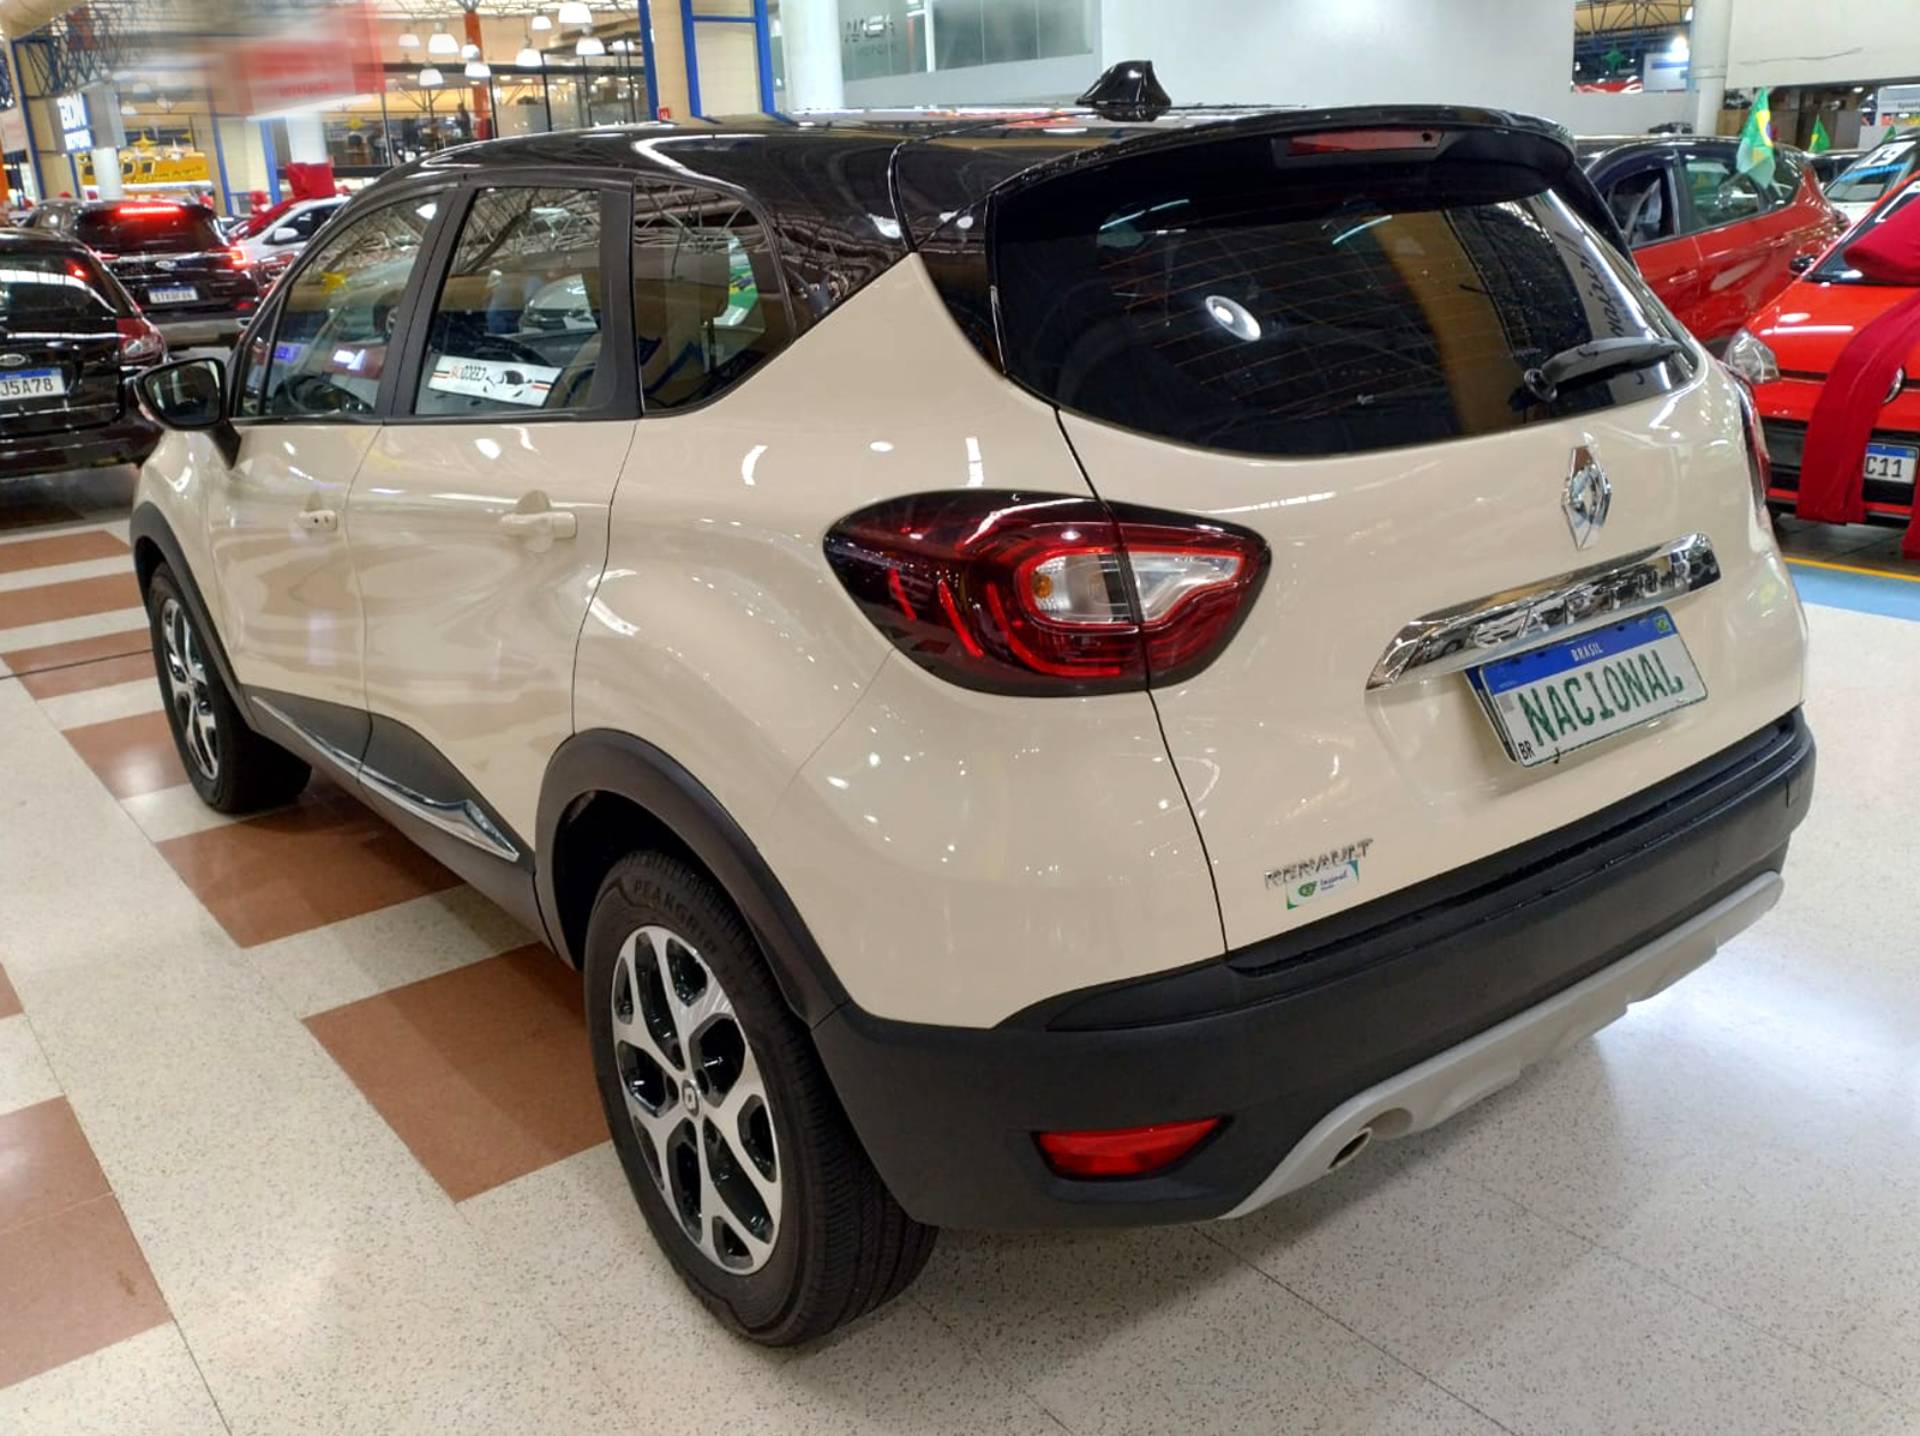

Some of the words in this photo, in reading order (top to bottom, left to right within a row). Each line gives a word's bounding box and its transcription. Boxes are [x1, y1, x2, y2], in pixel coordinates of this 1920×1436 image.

[1571, 642, 1603, 661] BRASIL
[1518, 650, 1684, 747] NACIONAL
[1518, 740, 1536, 760] BR
